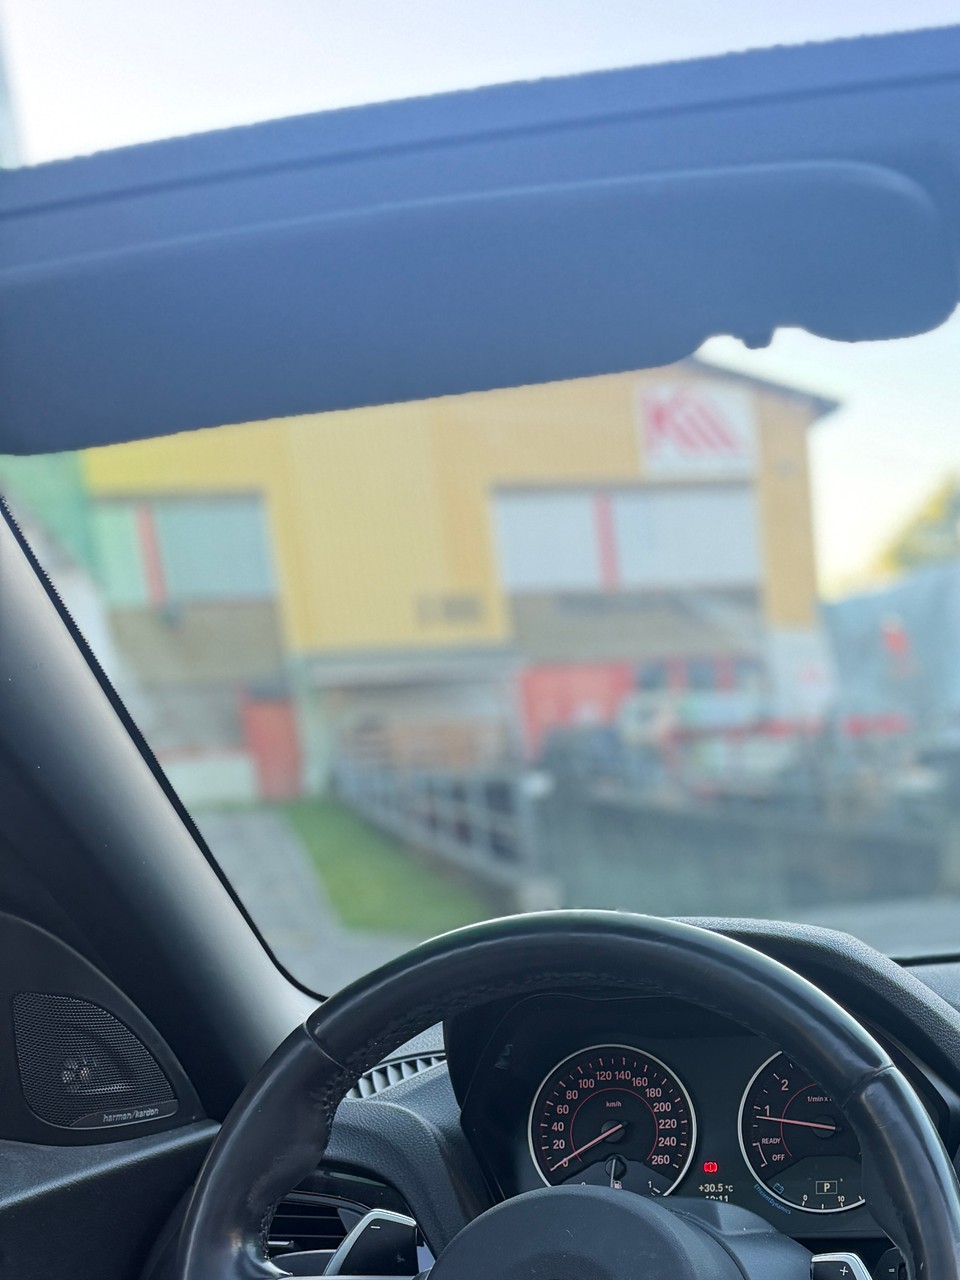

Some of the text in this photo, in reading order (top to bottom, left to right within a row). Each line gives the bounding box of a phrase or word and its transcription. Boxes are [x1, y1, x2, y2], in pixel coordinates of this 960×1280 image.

[596, 1071, 612, 1080] 120
[615, 1070, 631, 1079] 140
[578, 1079, 595, 1088] 100
[632, 1077, 648, 1086] 160
[781, 1079, 789, 1091] 2
[566, 1091, 578, 1100] 80
[645, 1088, 662, 1097] 180
[557, 1105, 569, 1114] 60
[653, 1102, 672, 1112] 200
[764, 1105, 770, 1116] 1
[552, 1122, 564, 1131] 40
[659, 1119, 677, 1129] 220
[553, 1140, 565, 1149] 20
[658, 1137, 677, 1147] 240
[652, 1155, 670, 1165] 260
[698, 1184, 724, 1192] +30.5
[823, 1183, 831, 1192] P
